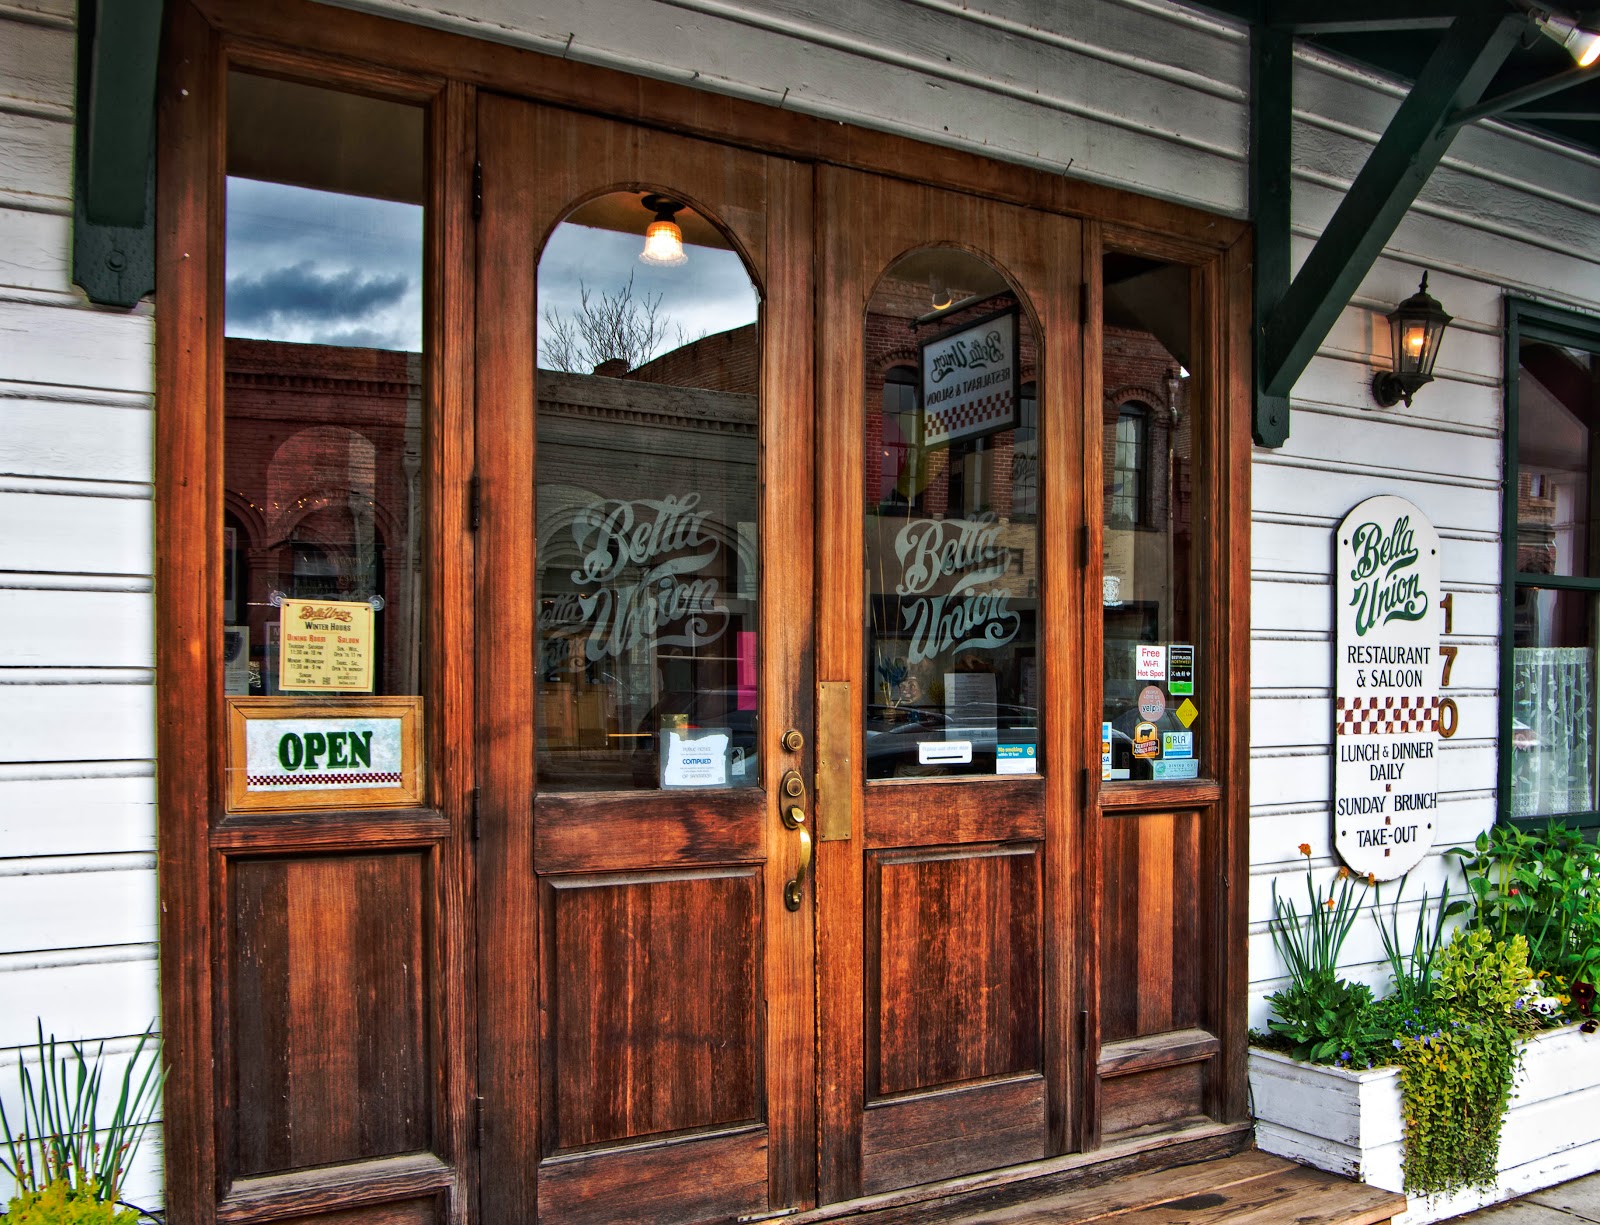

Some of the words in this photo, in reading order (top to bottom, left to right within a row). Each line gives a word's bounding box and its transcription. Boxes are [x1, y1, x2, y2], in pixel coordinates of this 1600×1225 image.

[571, 492, 720, 585] Bella
[1350, 515, 1419, 582] Bella
[895, 511, 1012, 597] Bella
[1349, 573, 1428, 637] Union
[578, 577, 730, 662] Union
[901, 587, 1021, 665] Union
[1141, 648, 1160, 657] Free
[1347, 646, 1431, 664] RESTAURANT
[1150, 670, 1164, 678] Spot
[1356, 669, 1366, 687] &
[1370, 669, 1423, 688] SALOON
[1142, 704, 1157, 714] yelp
[278, 731, 373, 771] OPEN
[1341, 744, 1380, 762] LUNCH
[1382, 746, 1389, 758] &
[1392, 742, 1434, 760] DINNER
[1370, 763, 1405, 781] DAILY
[1337, 795, 1387, 816] SUNDAY
[1393, 792, 1438, 811] BRUNCH
[1356, 825, 1418, 848] TAKE-OUT
